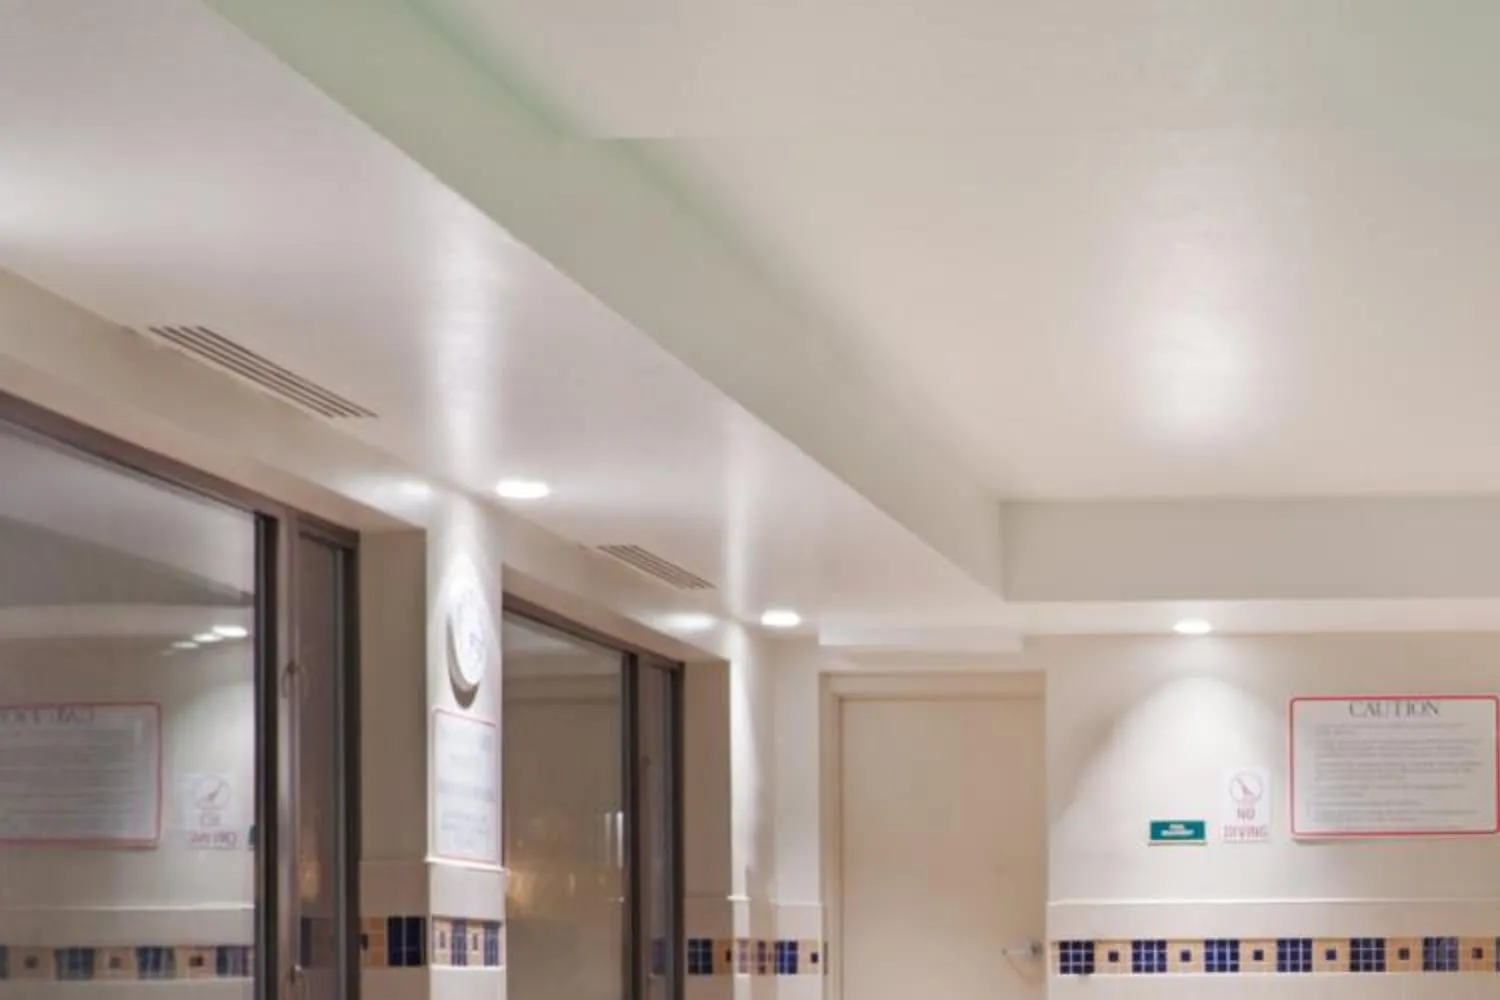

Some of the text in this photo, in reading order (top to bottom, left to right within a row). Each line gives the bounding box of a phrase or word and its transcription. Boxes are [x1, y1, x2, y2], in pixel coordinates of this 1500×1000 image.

[1348, 699, 1439, 718] CAUTION
[1236, 807, 1257, 820] NO
[1223, 823, 1269, 839] DIVING
